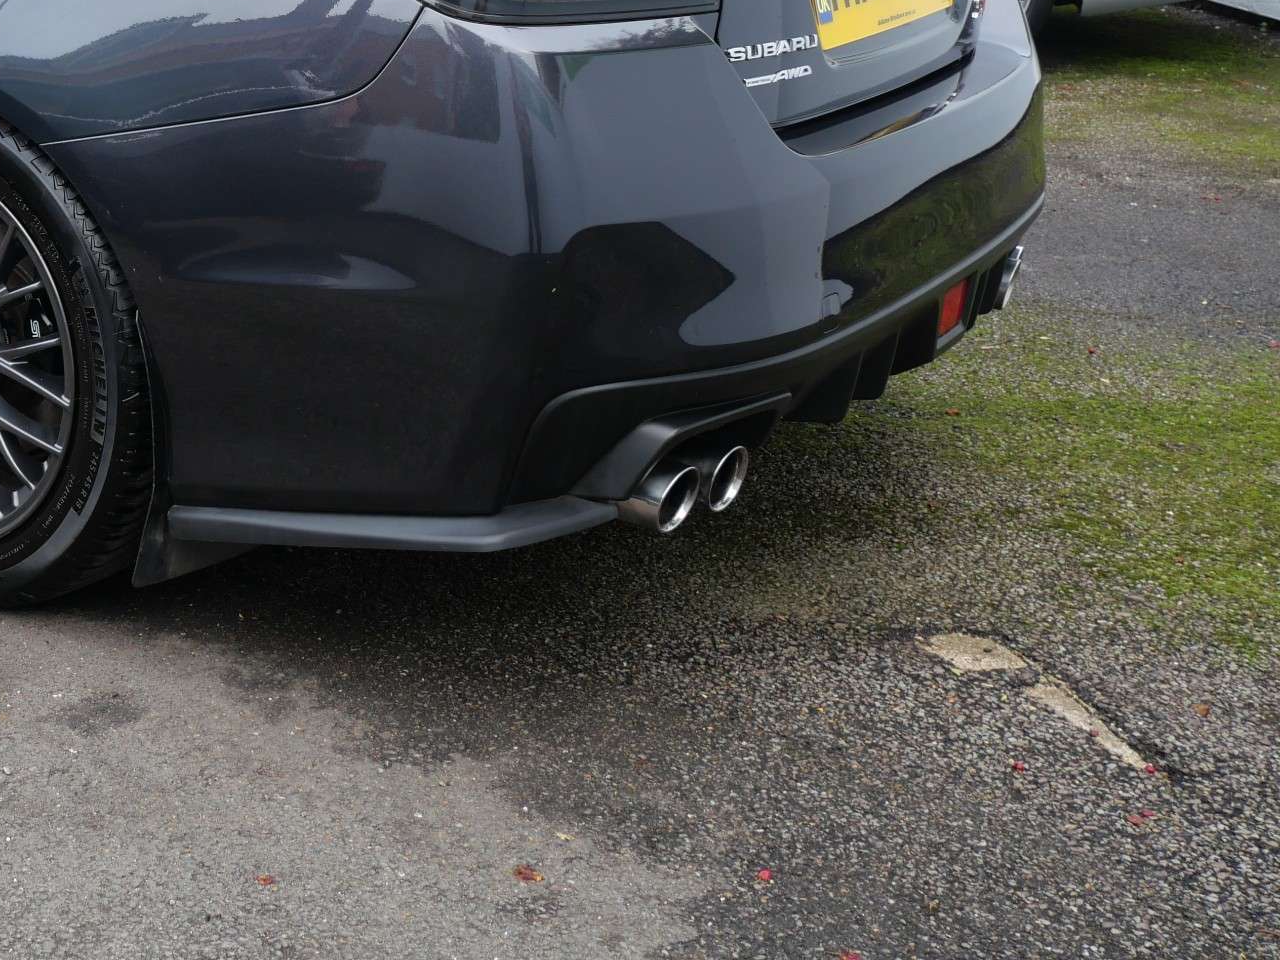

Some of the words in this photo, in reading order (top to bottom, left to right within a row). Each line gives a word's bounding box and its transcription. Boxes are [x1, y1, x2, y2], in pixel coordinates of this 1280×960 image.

[727, 33, 819, 62] SUBARU
[774, 65, 813, 83] AWD
[84, 306, 108, 437] MICHELIN
